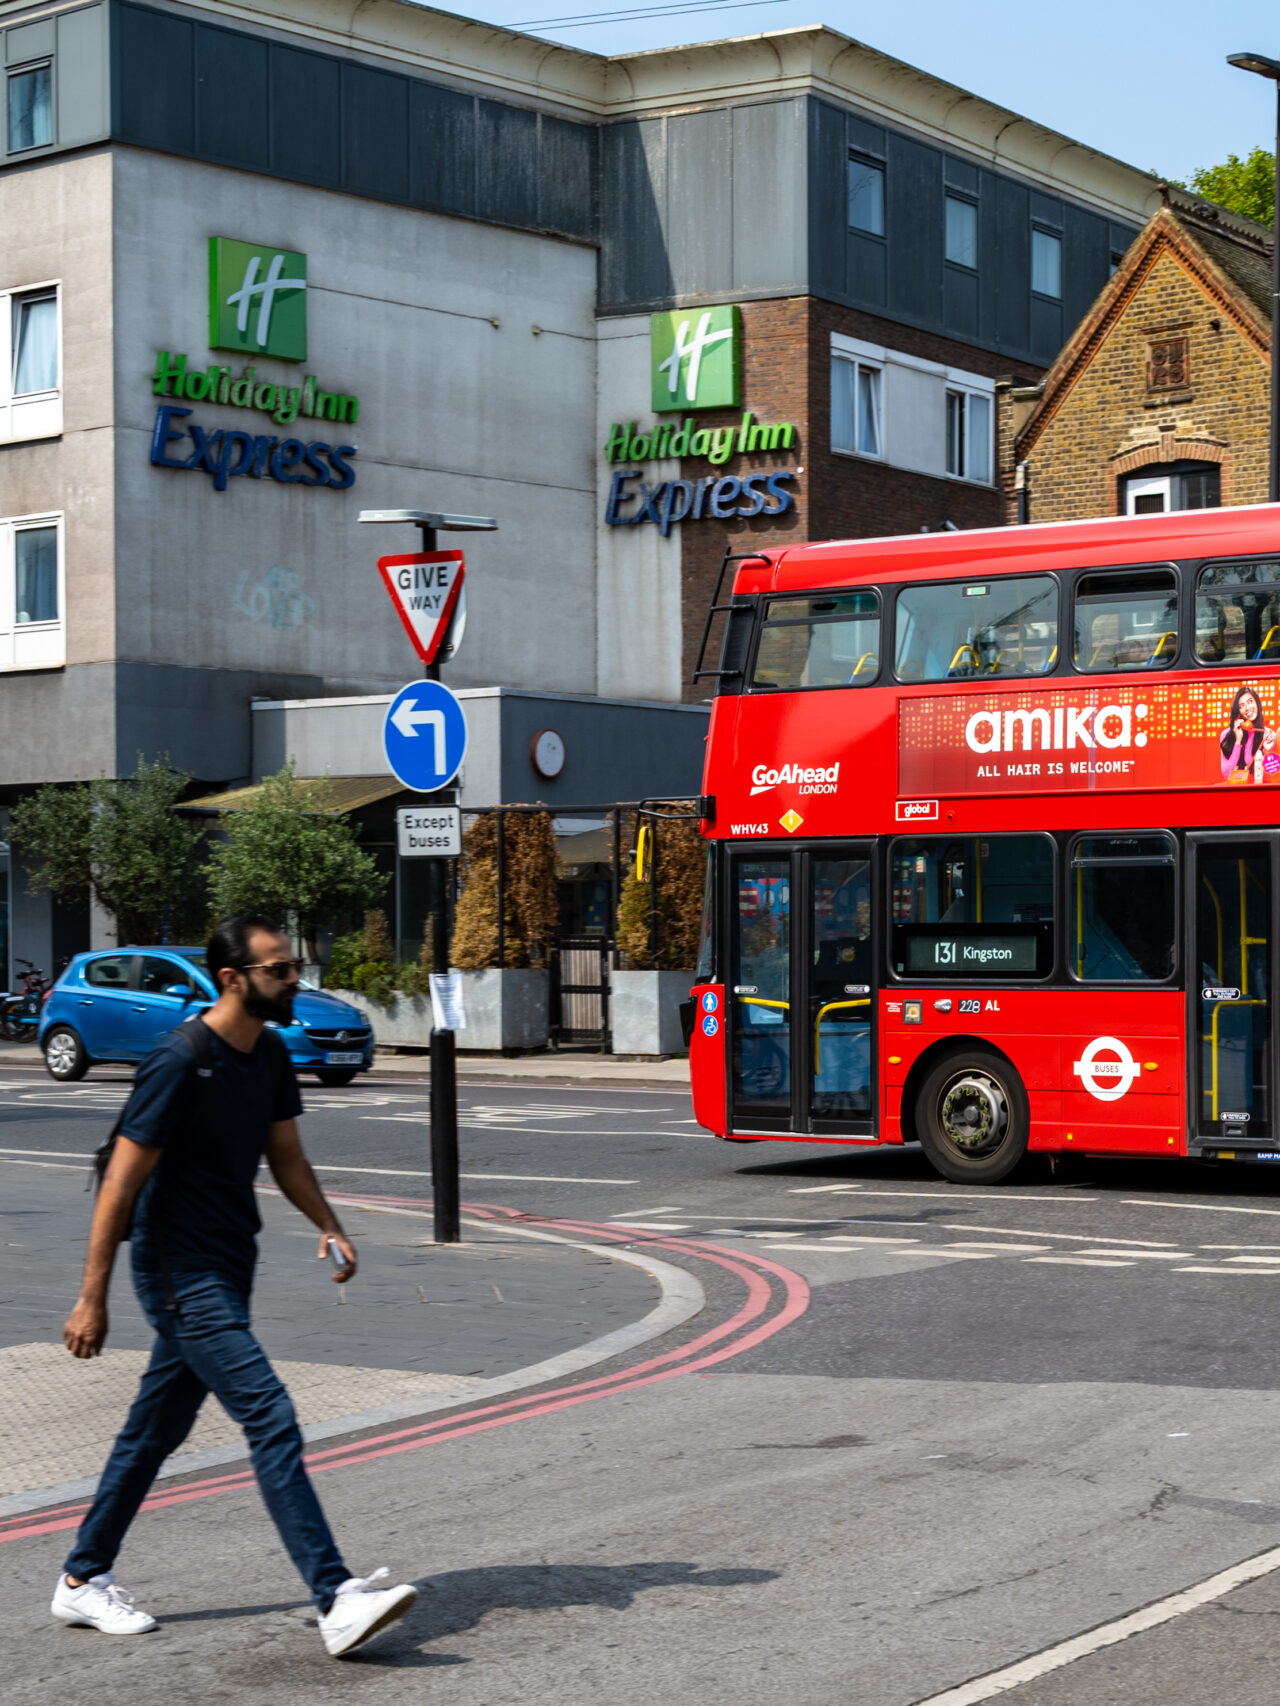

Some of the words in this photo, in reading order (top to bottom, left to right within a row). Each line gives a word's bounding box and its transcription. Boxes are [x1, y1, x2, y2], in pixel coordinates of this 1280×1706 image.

[152, 351, 300, 424] Holiday
[304, 375, 359, 424] Inn
[604, 418, 735, 465] Holiday
[738, 412, 795, 453] Inn
[150, 405, 357, 491] Express
[605, 470, 795, 538] Express
[398, 566, 448, 590] GIVE
[408, 594, 442, 610] WAY
[965, 703, 1148, 753] amika:
[751, 762, 840, 786] GoAhead
[977, 765, 1000, 777] ALL
[1007, 763, 1040, 776] HAIR
[1047, 763, 1064, 774] IS
[799, 784, 838, 794] LONDON
[904, 803, 930, 817] global
[404, 814, 454, 832] Except
[730, 824, 769, 835] WHV43
[409, 833, 450, 848] buses
[934, 942, 957, 964] 131
[963, 946, 1012, 963] Kingston
[985, 1000, 1000, 1011] AL
[1094, 1065, 1119, 1073] BUSES
